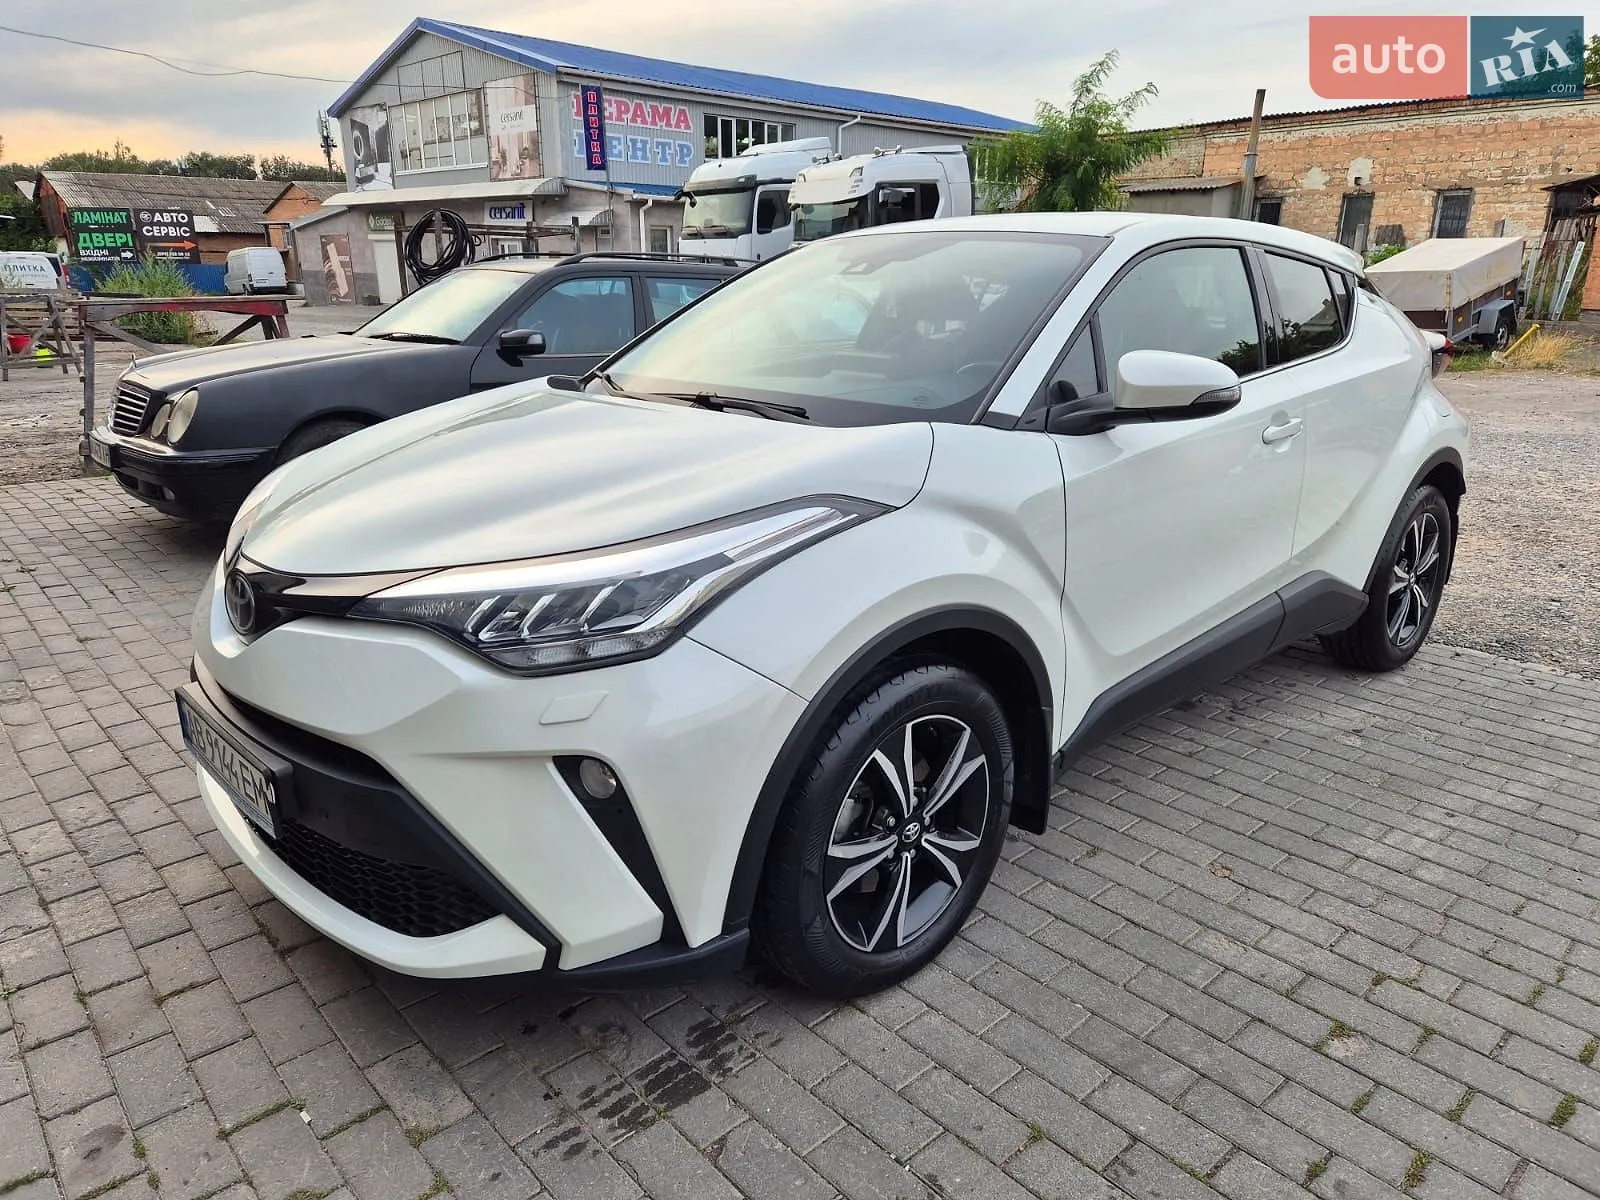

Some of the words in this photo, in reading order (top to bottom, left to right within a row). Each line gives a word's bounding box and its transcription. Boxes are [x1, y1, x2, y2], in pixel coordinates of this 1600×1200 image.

[588, 91, 602, 165] ПЛИТКА
[489, 202, 526, 220] cersanit
[73, 211, 128, 224] ЛАМІНАТ
[153, 212, 189, 223] АВТО
[142, 225, 191, 237] СЕРВІС
[77, 232, 134, 249] ДВЕРІ
[79, 249, 109, 257] ВХІДНІ
[3, 264, 46, 273] ПЛИТКА
